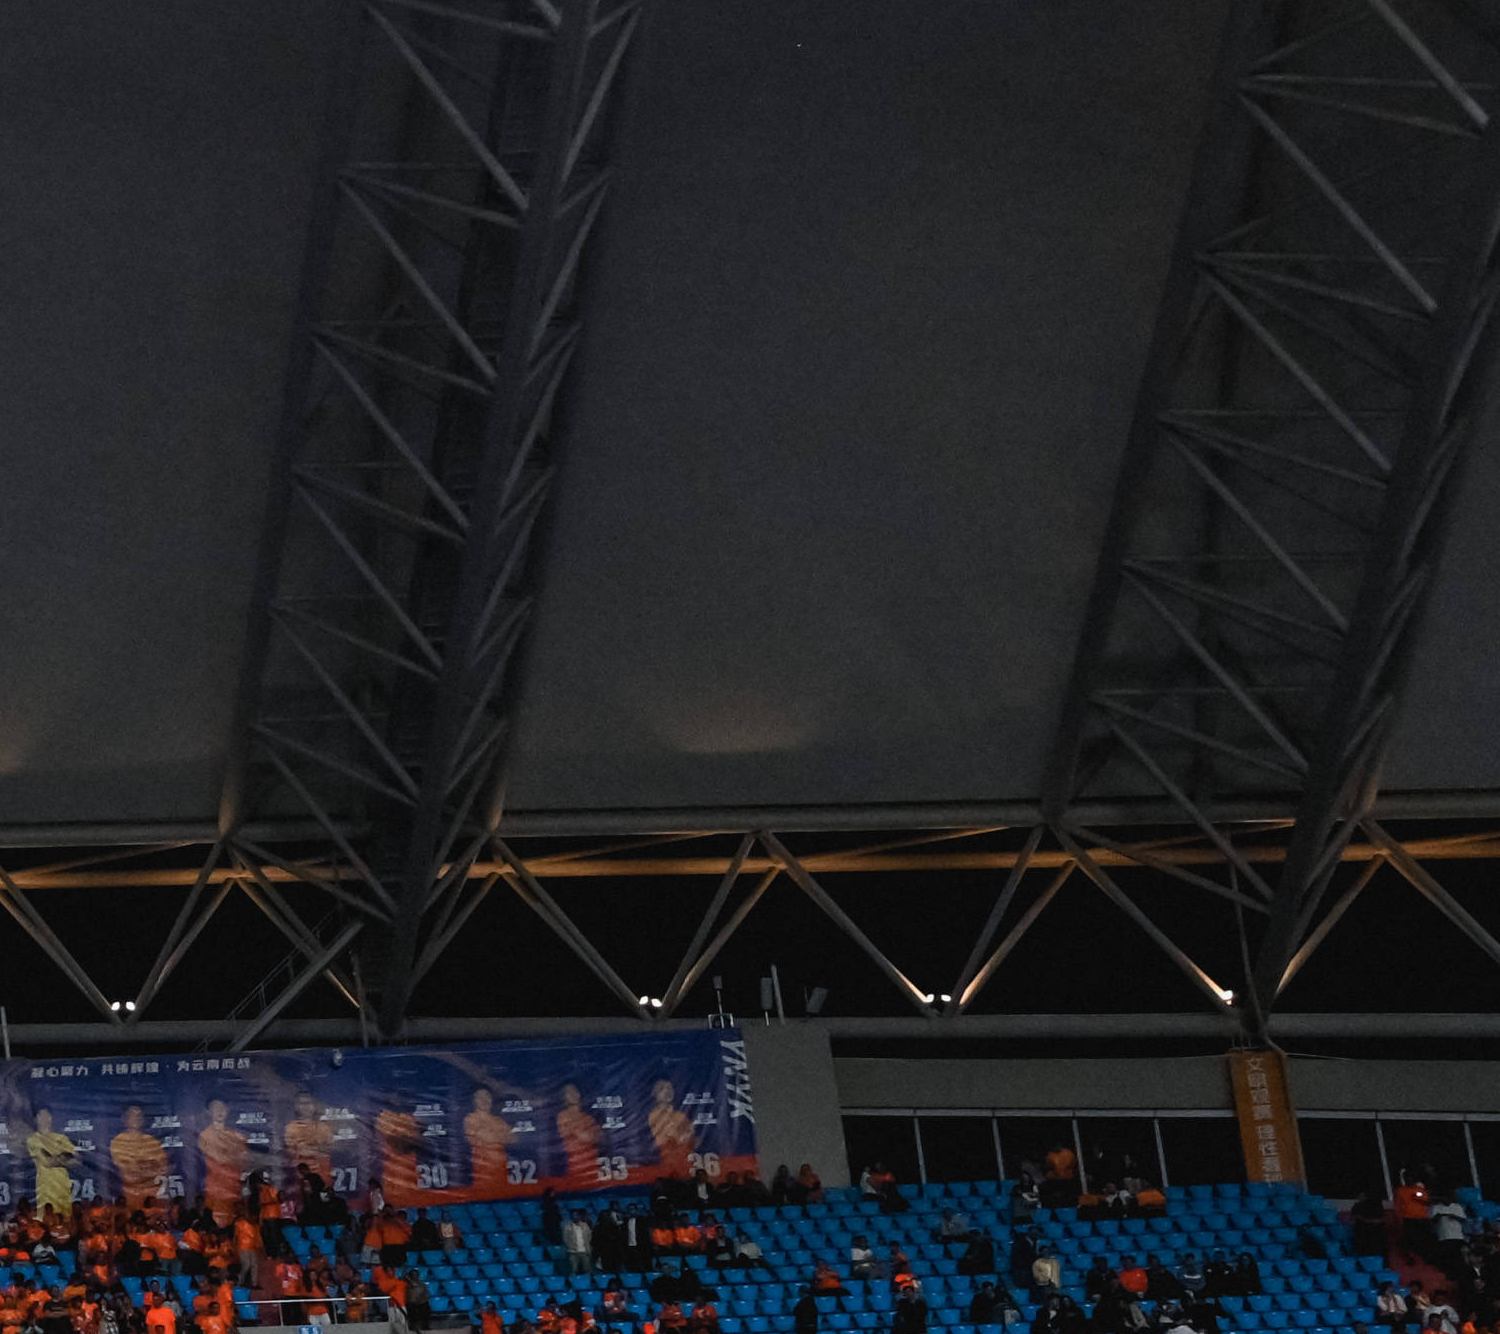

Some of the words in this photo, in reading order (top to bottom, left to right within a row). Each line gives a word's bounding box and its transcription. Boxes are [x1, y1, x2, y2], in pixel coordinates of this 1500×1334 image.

[332, 1169, 358, 1192] 27
[417, 1164, 449, 1188] 30
[507, 1160, 538, 1184] 32
[596, 1156, 628, 1181] 33
[70, 1178, 97, 1202] 24
[154, 1175, 185, 1199] 25
